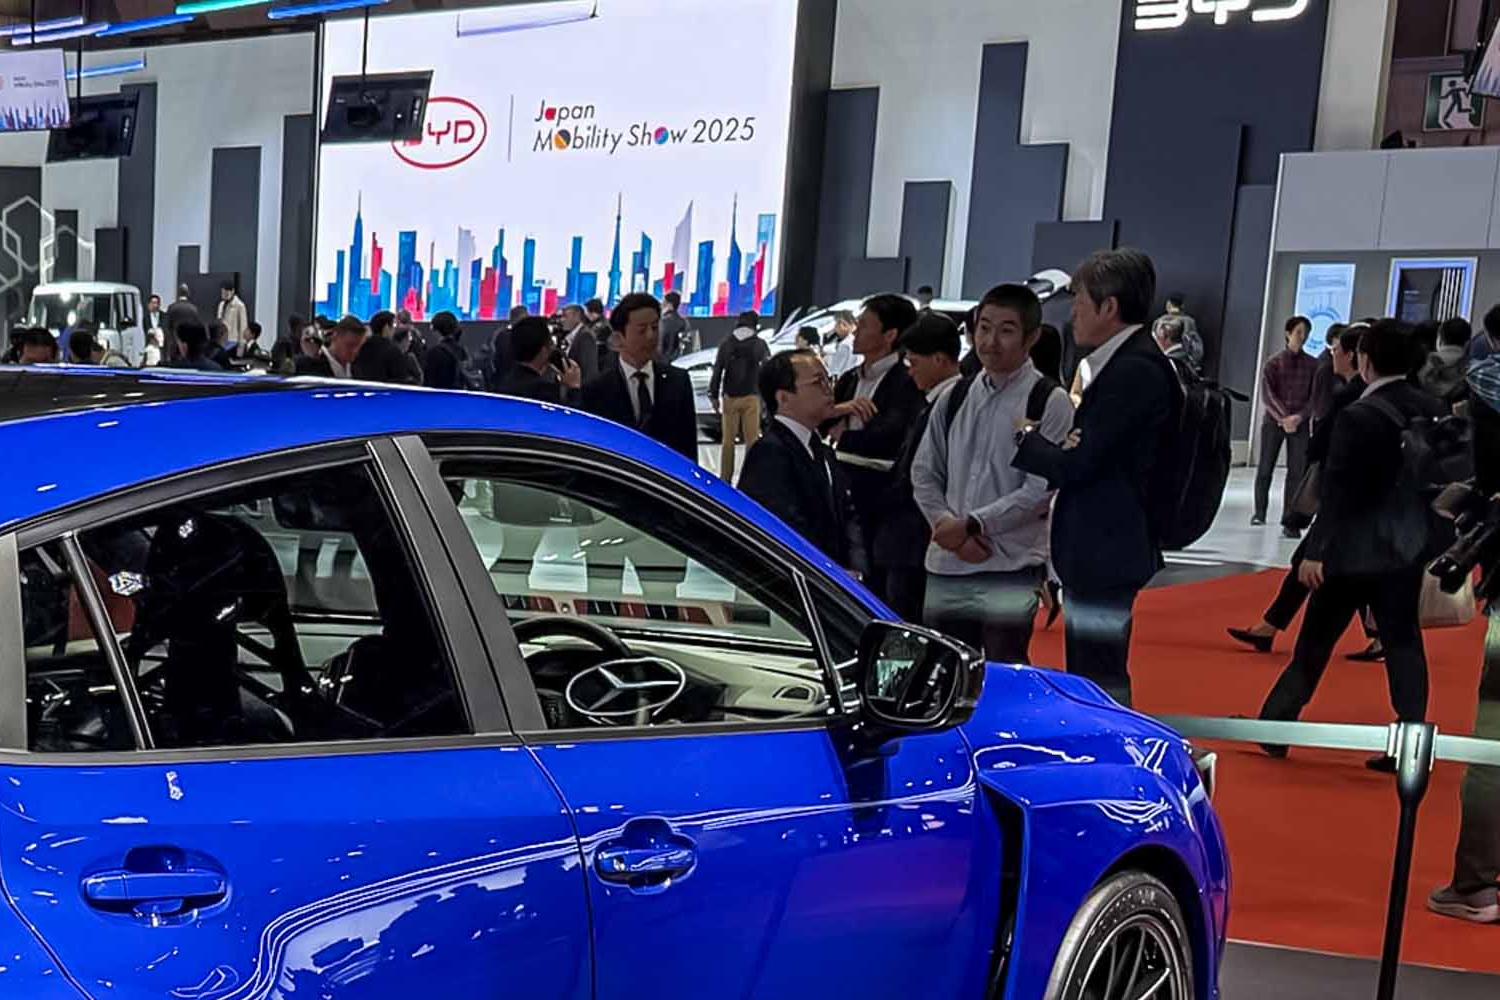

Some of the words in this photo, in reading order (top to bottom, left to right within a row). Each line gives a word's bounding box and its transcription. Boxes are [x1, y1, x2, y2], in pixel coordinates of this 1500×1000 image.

[534, 99, 595, 127] Japan
[532, 125, 623, 154] Mobility
[627, 121, 688, 147] Show
[692, 116, 756, 144] 2025
